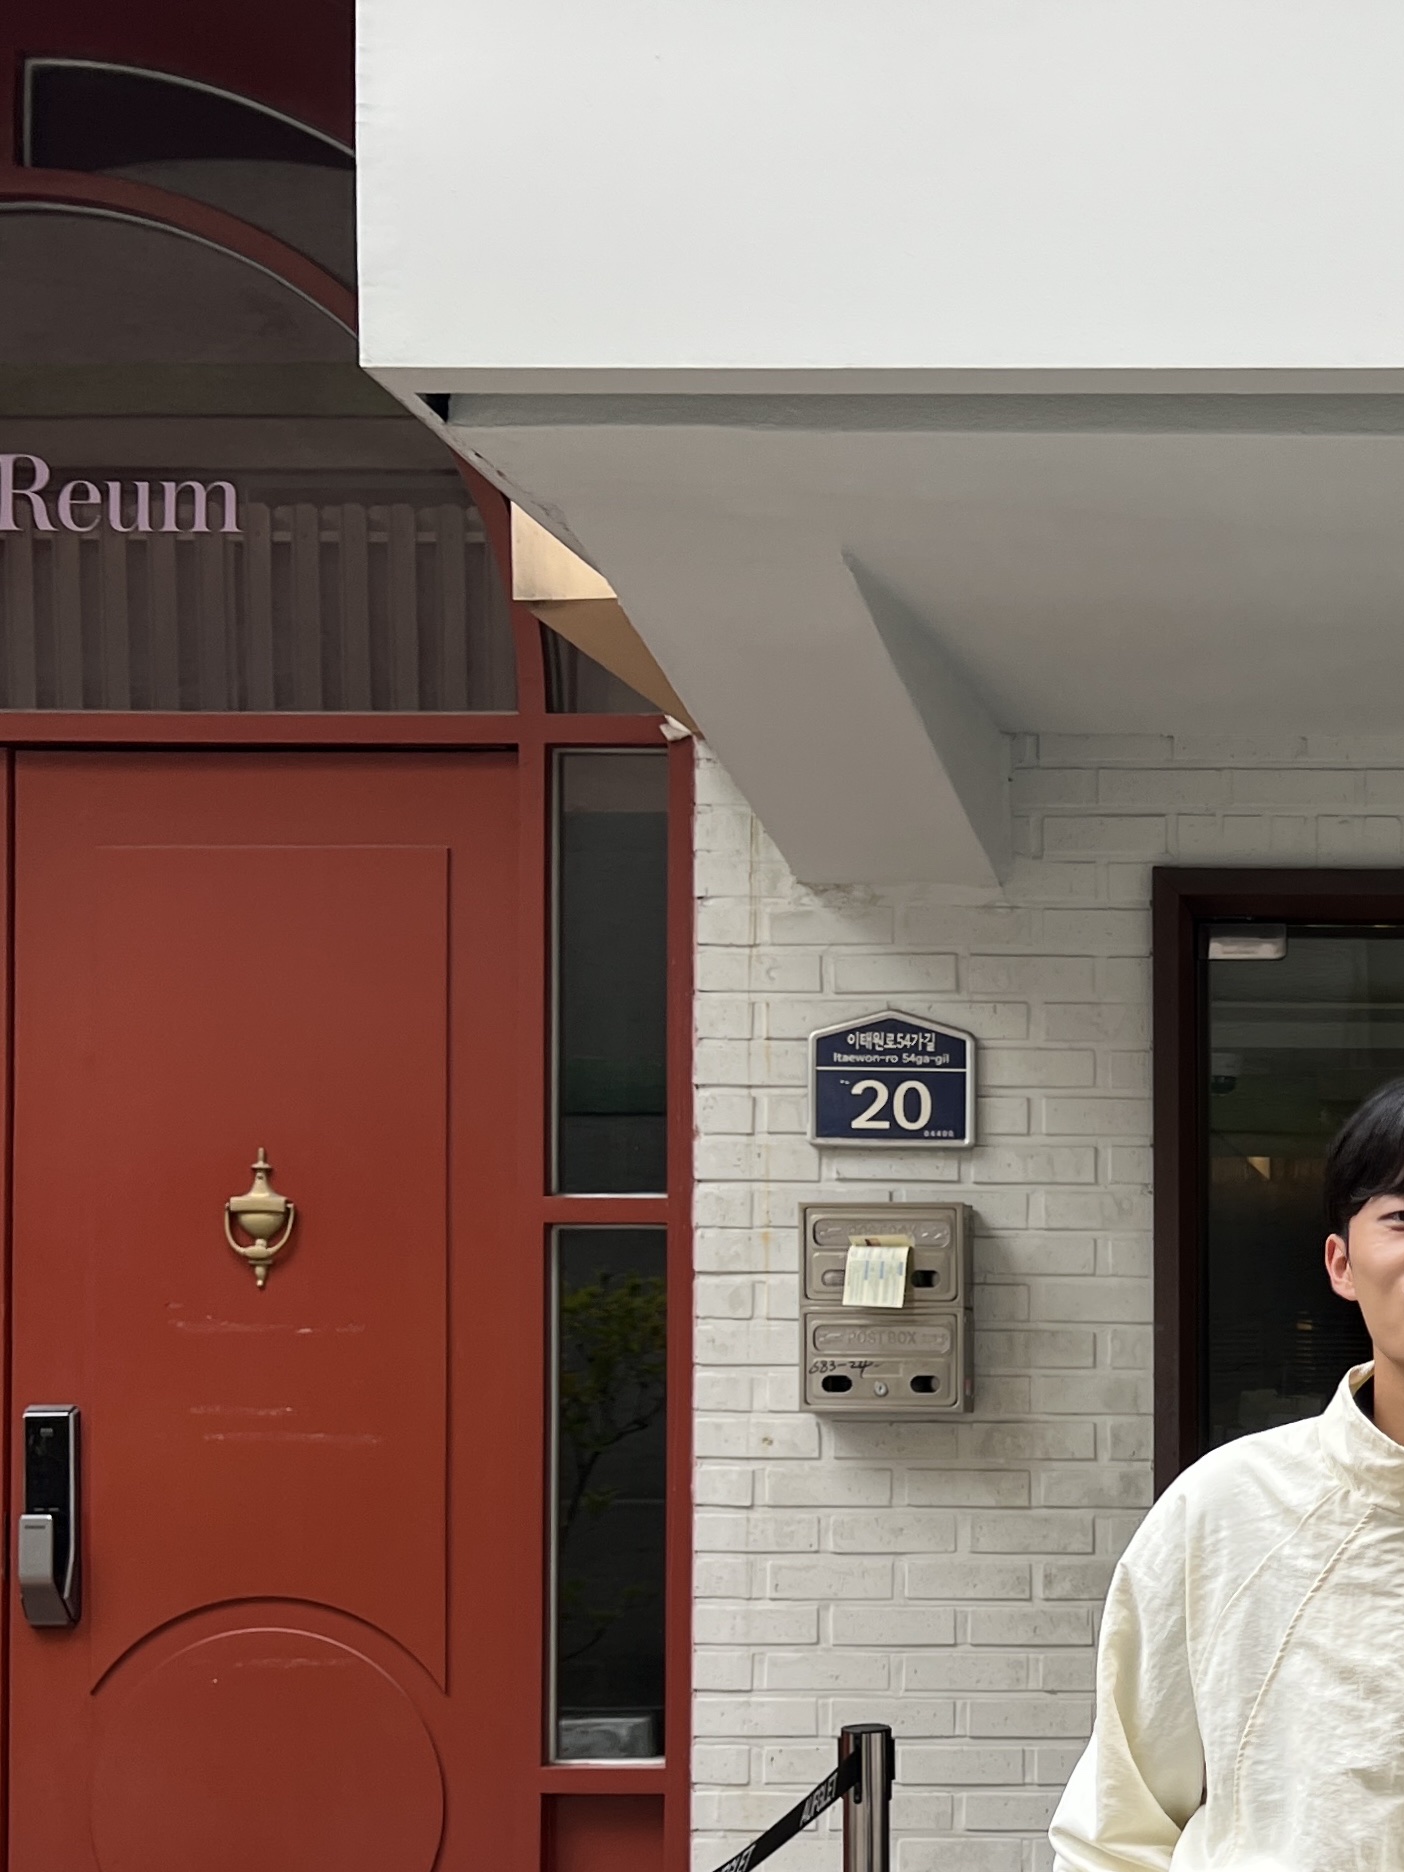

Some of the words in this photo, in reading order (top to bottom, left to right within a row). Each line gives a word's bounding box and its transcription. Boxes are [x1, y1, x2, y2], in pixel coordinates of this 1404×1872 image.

[0, 453, 243, 533] Reum
[833, 1052, 899, 1064] Itaewon-ro
[902, 1053, 950, 1066] 54ga-gil
[846, 1031, 936, 1052] 이태원로54가길
[850, 1079, 932, 1131] 20
[847, 1330, 885, 1344] POST
[887, 1330, 917, 1344] BOX
[799, 1773, 839, 1827] AUFGLET
